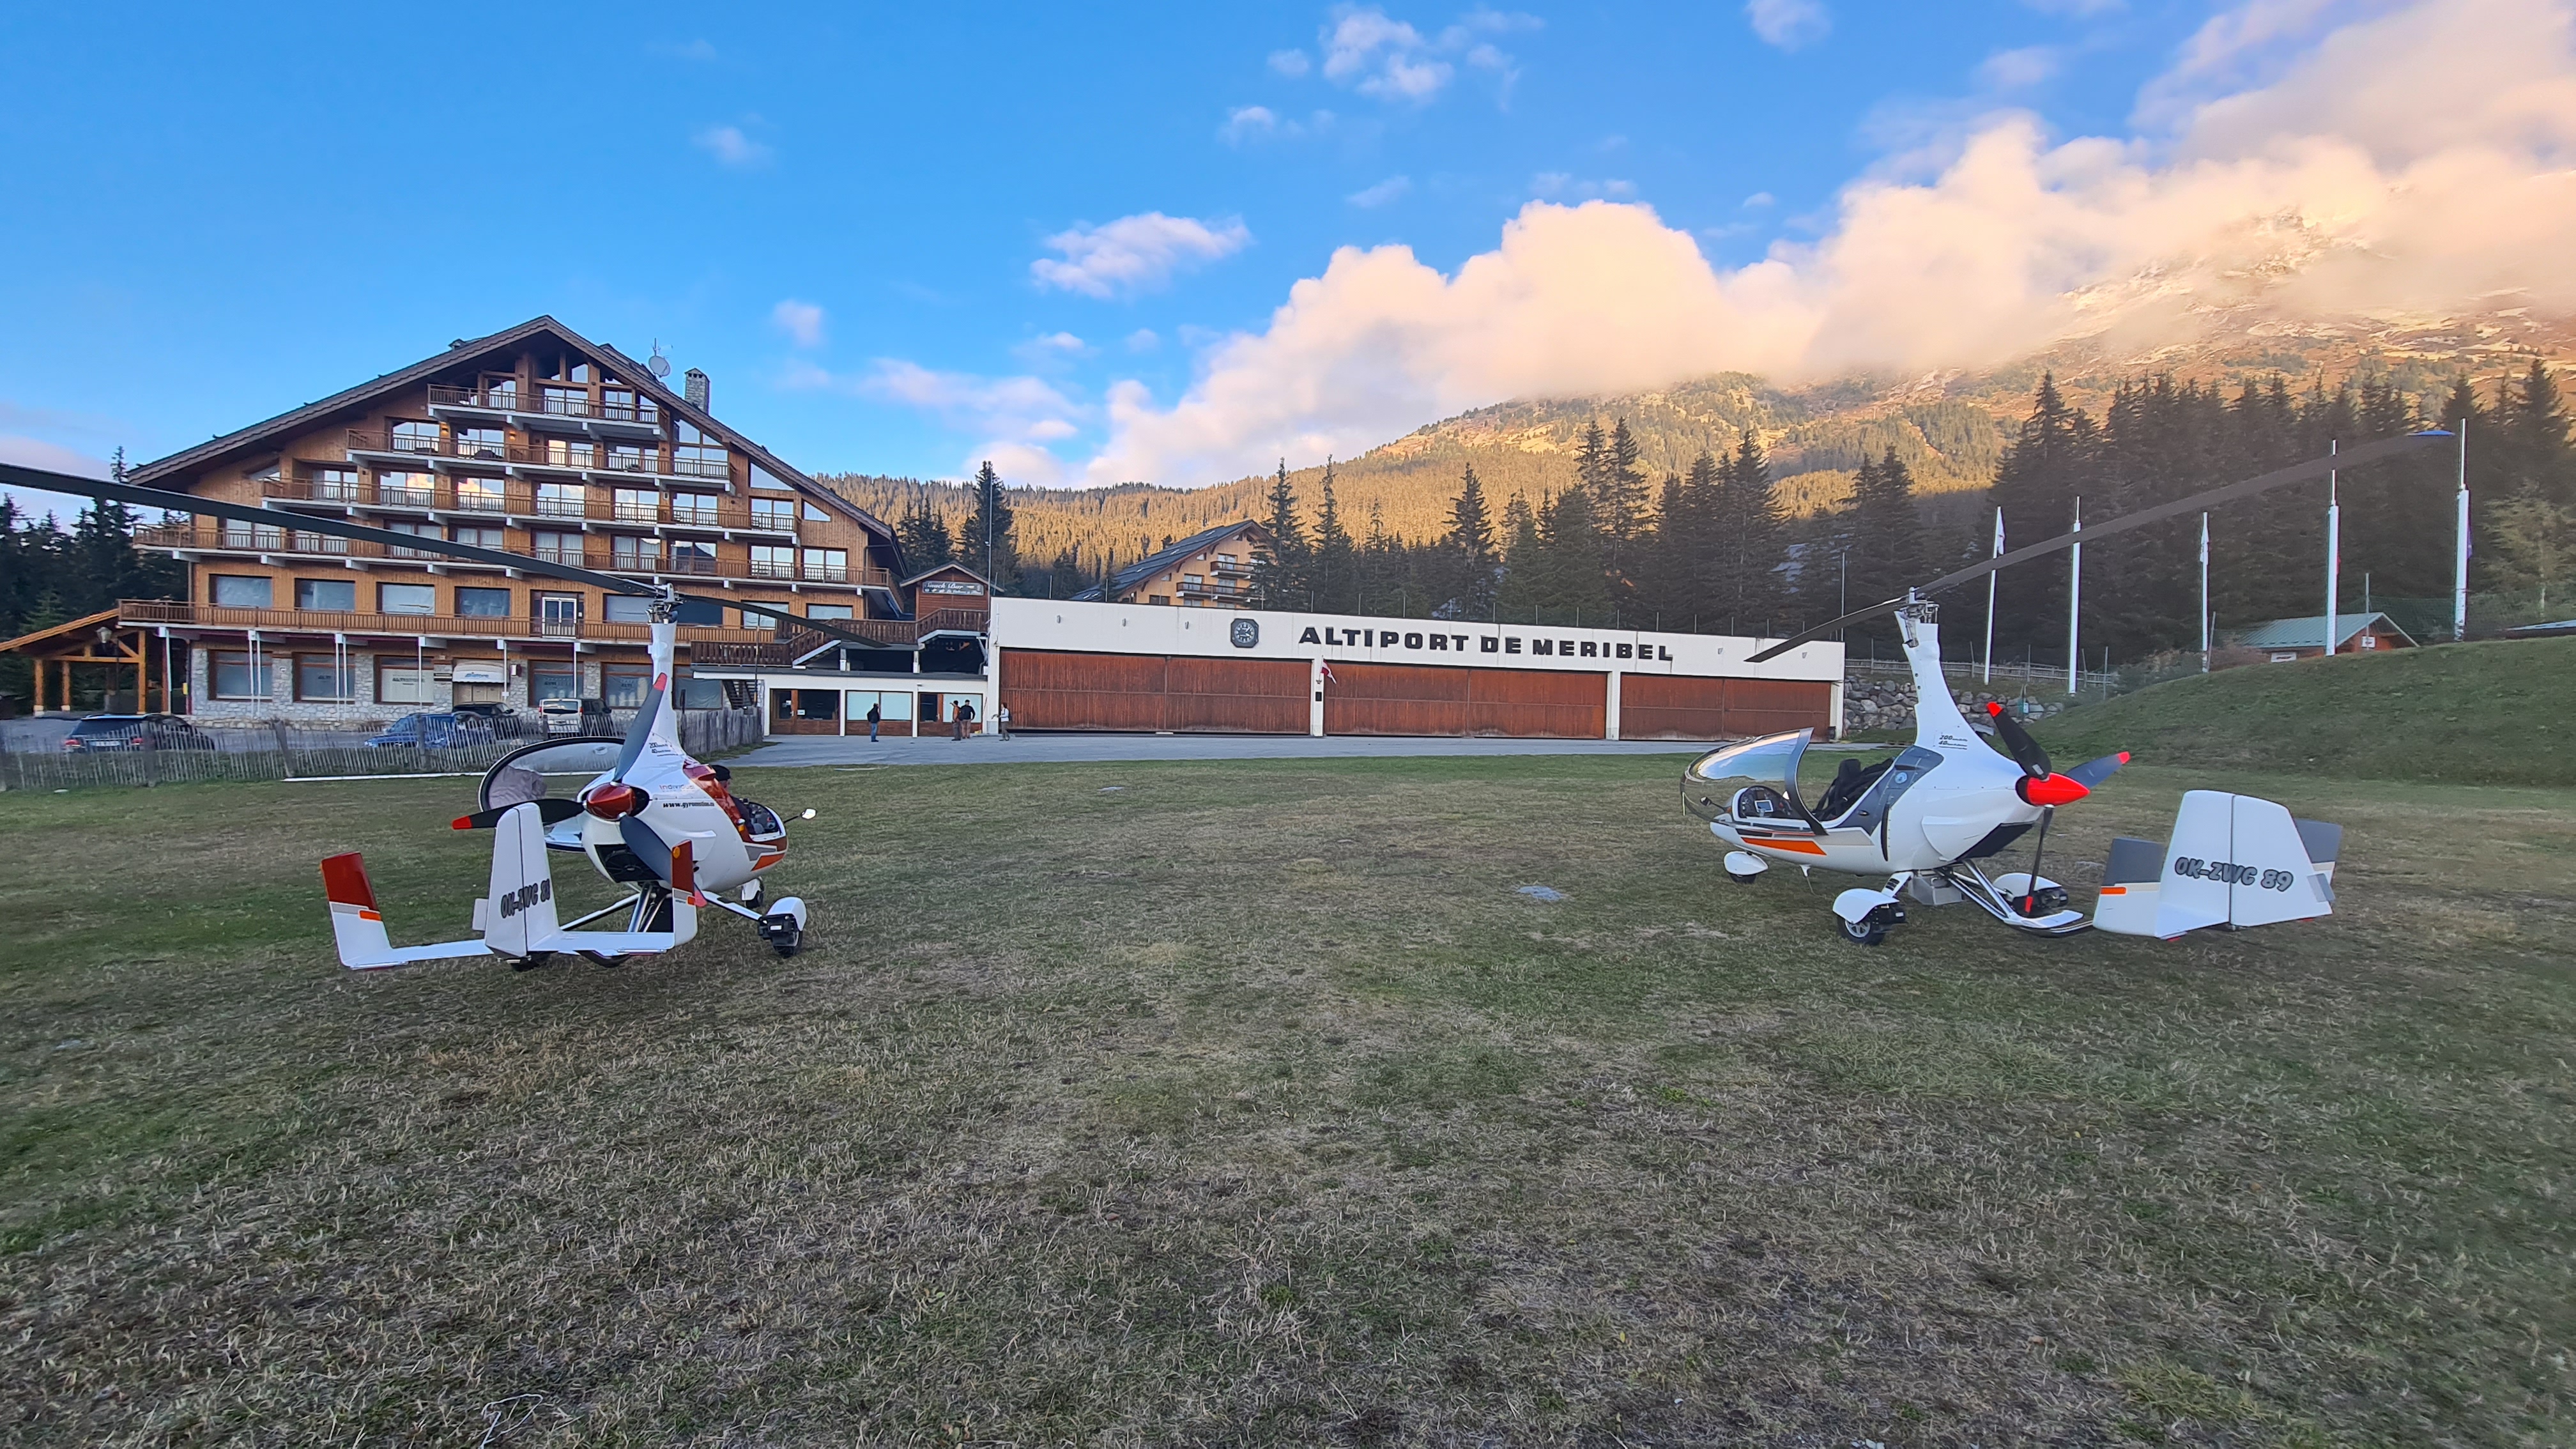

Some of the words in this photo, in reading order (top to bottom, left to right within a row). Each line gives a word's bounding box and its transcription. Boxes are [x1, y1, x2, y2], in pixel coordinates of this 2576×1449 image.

[1298, 627, 1469, 651] ALTIPORT
[1480, 636, 1521, 654] DE
[1533, 639, 1673, 661] MERIBEL
[2175, 857, 2257, 885] OK-ZWC
[2260, 869, 2294, 892] 89
[501, 883, 538, 918] OK-ZWC
